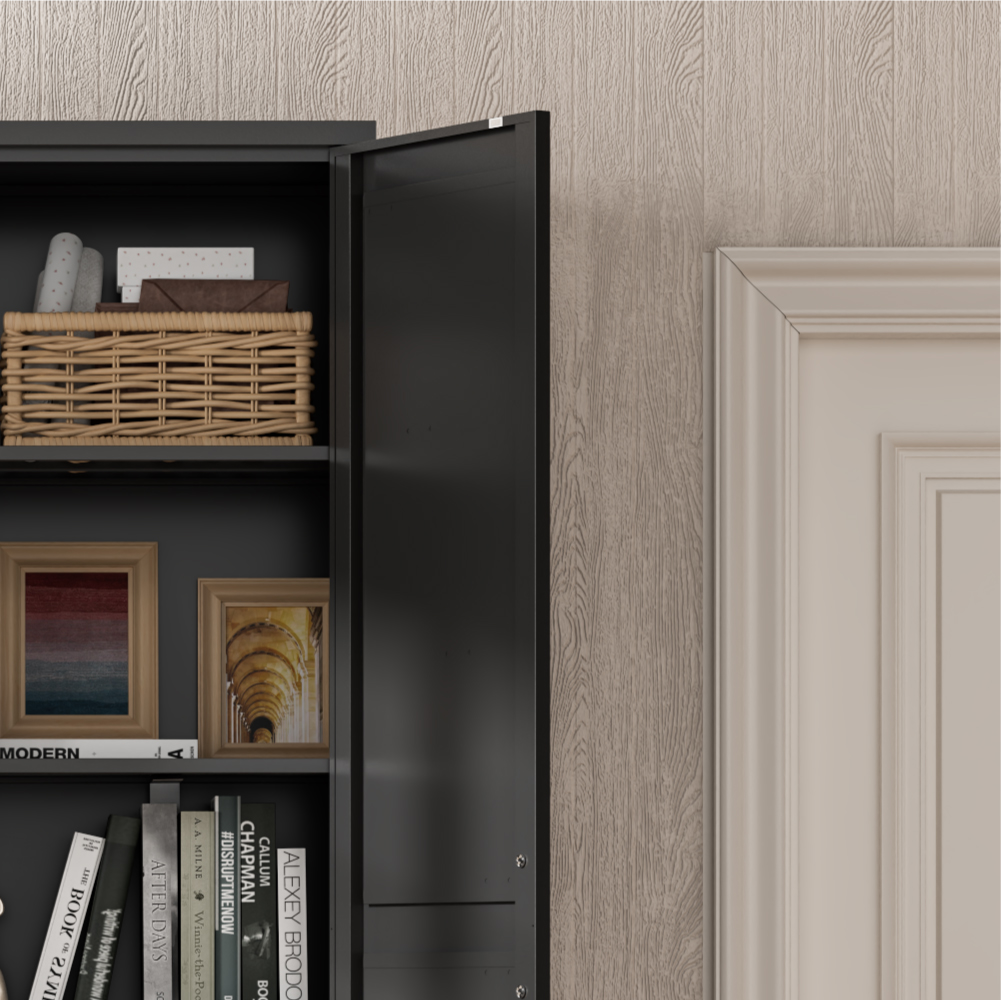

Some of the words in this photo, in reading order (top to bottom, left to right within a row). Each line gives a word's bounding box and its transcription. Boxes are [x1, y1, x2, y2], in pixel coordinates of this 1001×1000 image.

[0, 747, 80, 759] MODERN
[194, 817, 202, 828] A.
[194, 830, 202, 841] A.
[194, 844, 202, 879] MILNE
[221, 830, 234, 935] #DISRUPTMENOW
[240, 820, 256, 904] CHAPMAN
[259, 837, 270, 887] CALLUM
[151, 860, 167, 914] AFTER
[283, 851, 301, 925] ALEXEY
[151, 919, 168, 962] DAYS
